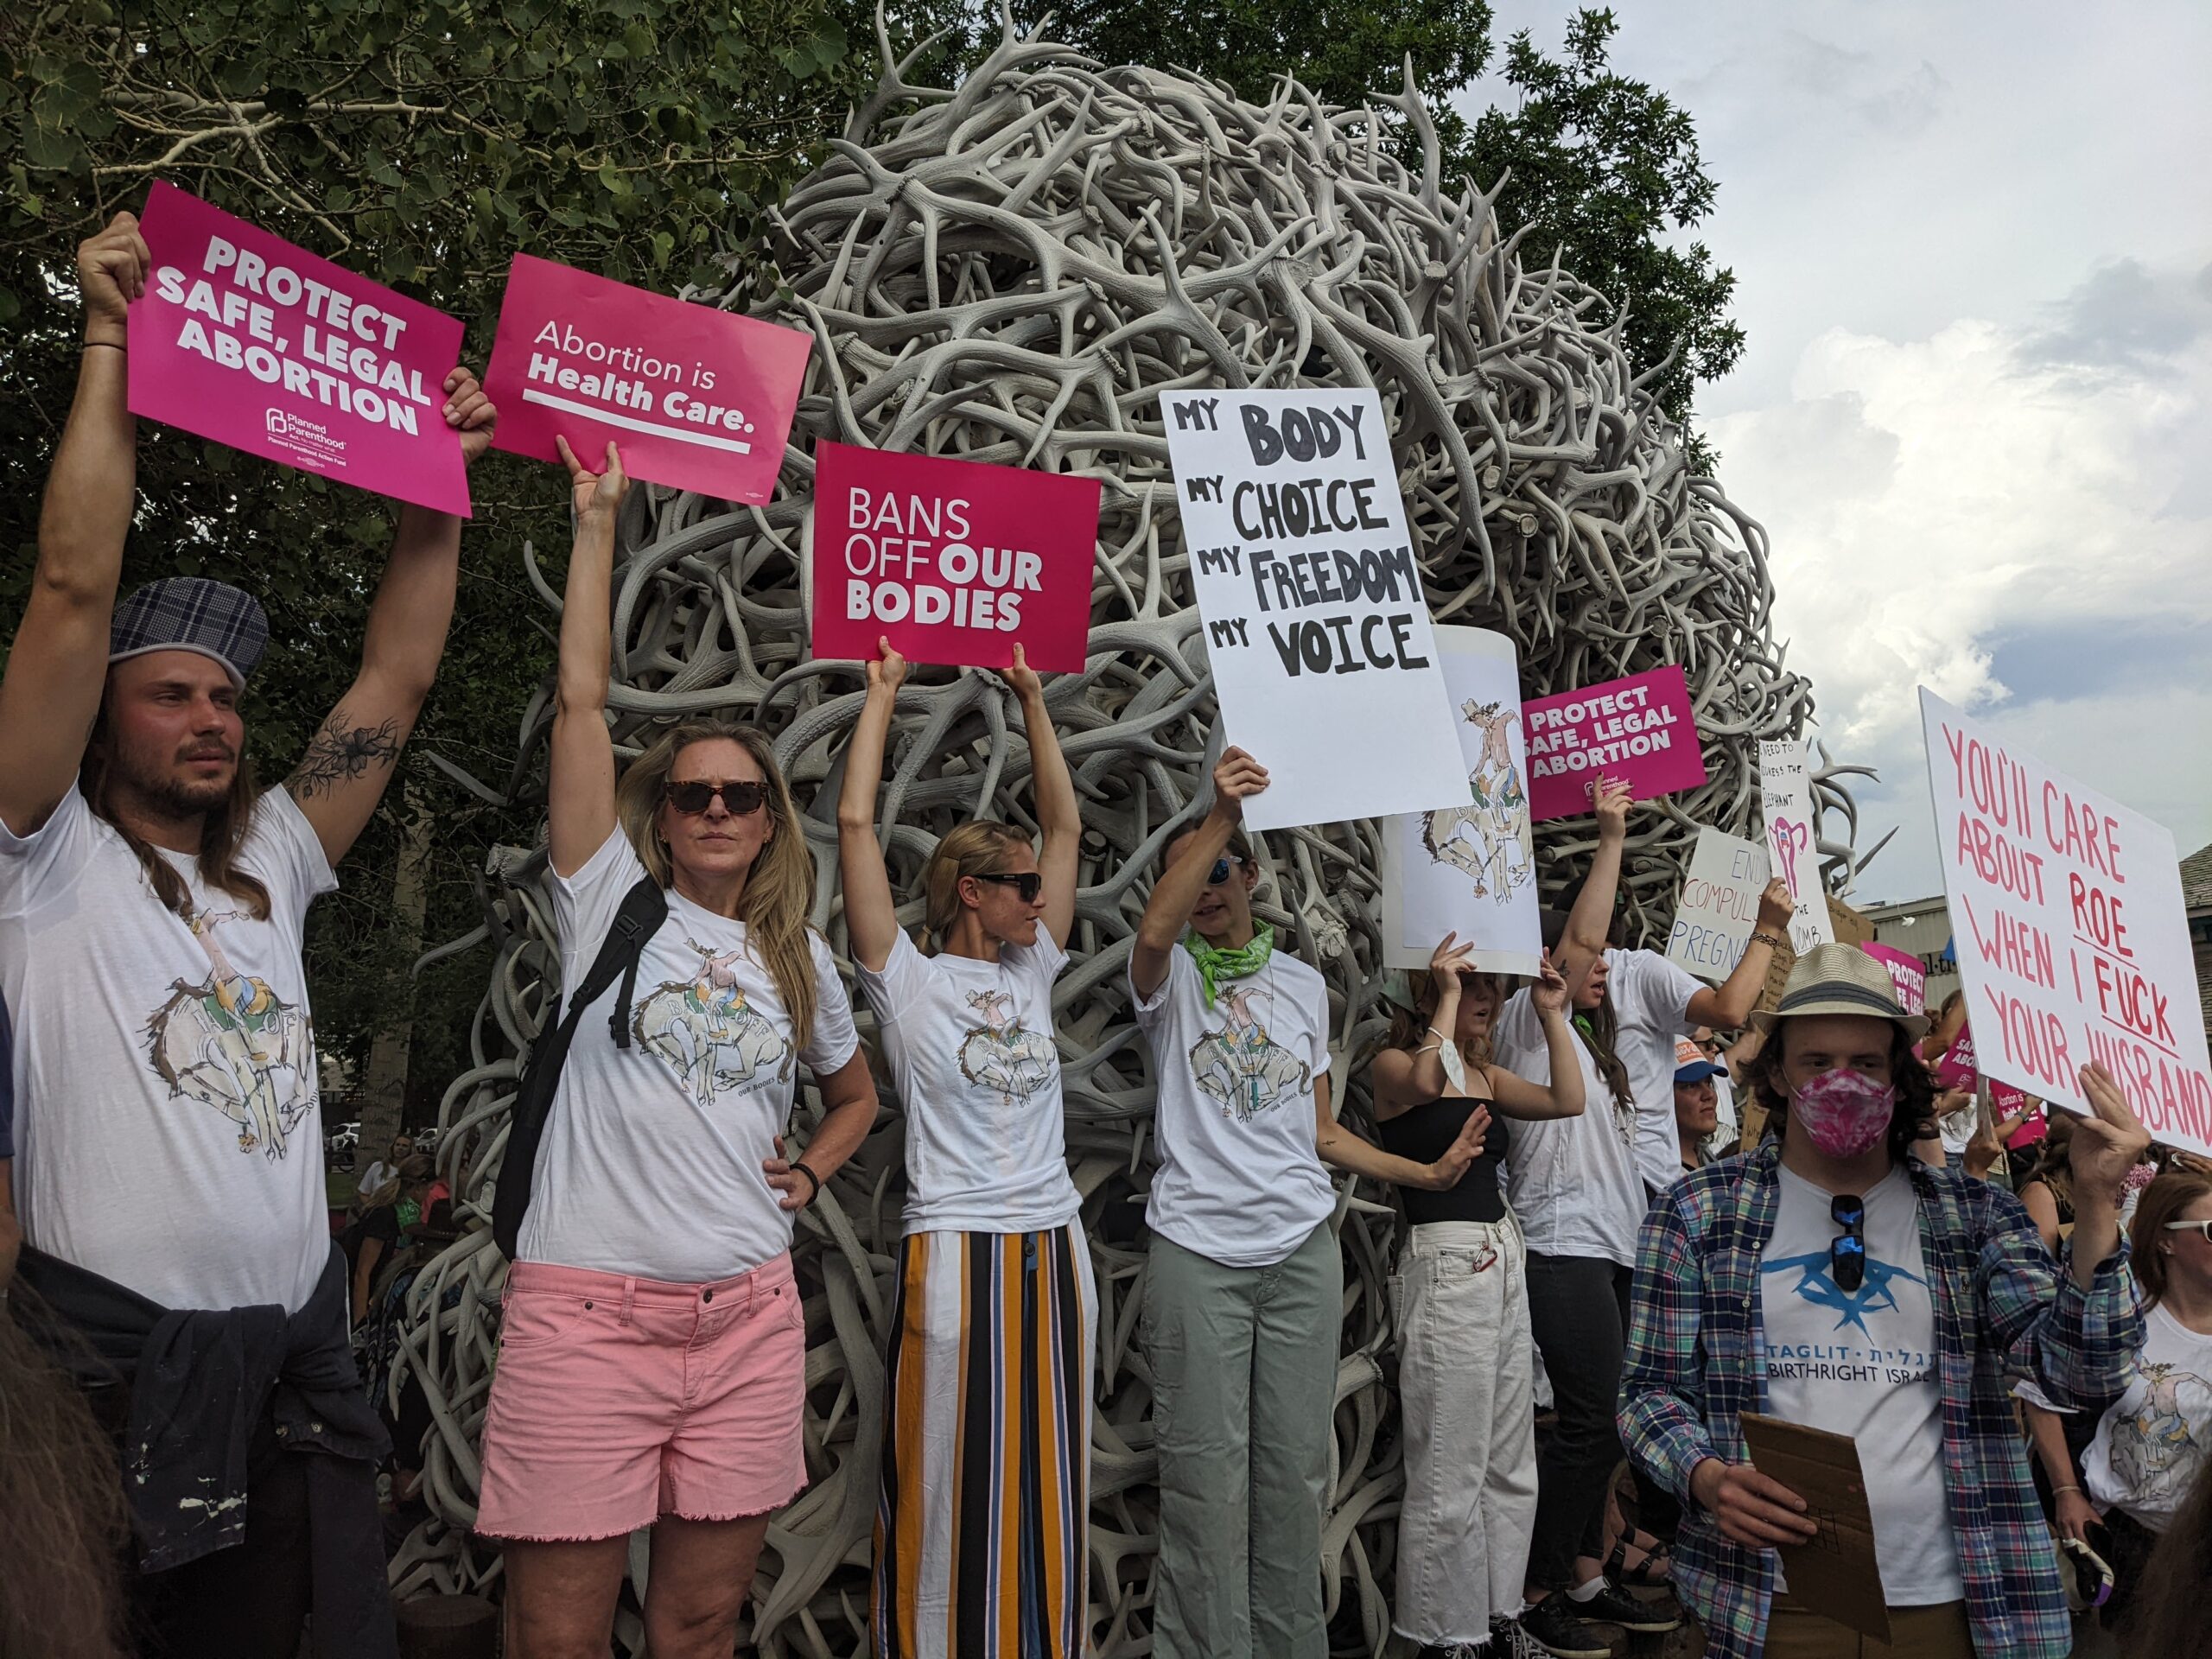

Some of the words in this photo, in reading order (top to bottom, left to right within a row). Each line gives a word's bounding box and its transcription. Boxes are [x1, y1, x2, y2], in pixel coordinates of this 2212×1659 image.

[203, 235, 407, 351] PROTECT
[156, 266, 289, 353] SAFE,
[303, 324, 431, 406] LEGAL
[534, 321, 682, 383] Abortion
[692, 362, 716, 390] is
[176, 319, 419, 436] ABORTION
[527, 353, 653, 411] Health
[663, 391, 755, 434] Care.
[287, 413, 327, 435] Planned
[289, 423, 345, 449] Parenthood
[1172, 397, 1220, 431] MY
[1239, 404, 1367, 467] BODY
[849, 486, 971, 540] BANS
[1185, 474, 1224, 504] MY
[1232, 478, 1390, 542] CHOICE
[845, 533, 931, 580] OFF
[938, 543, 1043, 592] OUR
[1197, 545, 1242, 576] MY
[1249, 545, 1421, 612] FREEDOM
[847, 579, 1023, 632] BODIES
[1208, 617, 1249, 649] MY
[1266, 613, 1430, 677] VOICE
[1529, 685, 1649, 732] PROTECT
[1593, 704, 1678, 742] LEGAL
[1533, 729, 1672, 779] ABORTION
[1782, 743, 1794, 754] TO
[1787, 765, 1802, 774] THE
[2043, 779, 2126, 885] CARE
[1682, 878, 1763, 923] COMPUL
[1958, 810, 2044, 906] ABOUT
[2069, 871, 2134, 958] ROE
[1795, 904, 1809, 918] THE
[1668, 920, 1747, 971] PREGN
[1962, 893, 2056, 990] WHEN
[2069, 947, 2082, 1004] I
[2093, 955, 2177, 1046] FUCK
[1885, 958, 1924, 995] PROTECT
[1984, 982, 2082, 1100] YOUR
[738, 1086, 752, 1097] OUR
[753, 1076, 775, 1090] BODIES
[1765, 1344, 1850, 1361] TAGLIT
[1769, 1363, 1878, 1382] BIRTHRIGHT
